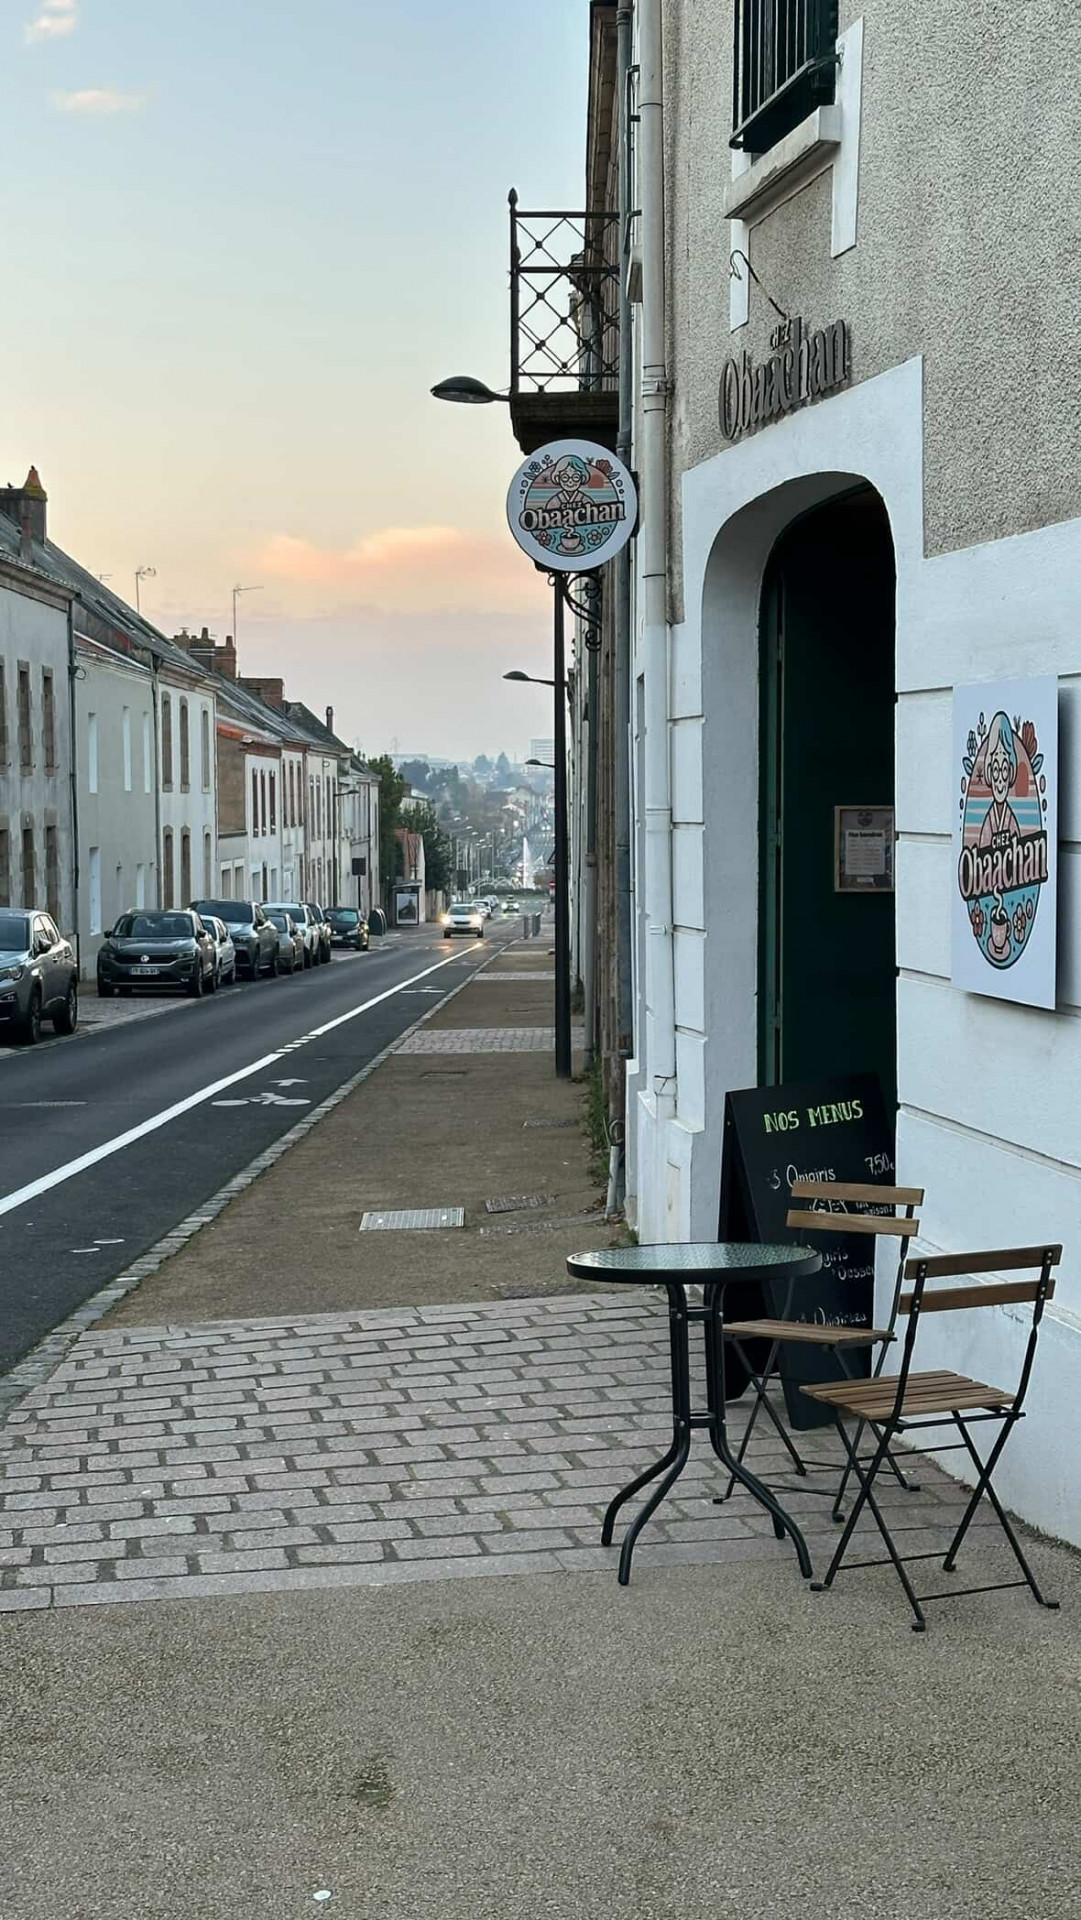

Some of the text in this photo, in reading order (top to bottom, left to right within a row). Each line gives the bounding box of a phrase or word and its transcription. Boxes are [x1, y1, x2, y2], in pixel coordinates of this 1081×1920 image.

[718, 316, 847, 440] Obaachan
[520, 502, 625, 531] Obaachan
[561, 502, 582, 510] CHEZ
[991, 832, 1011, 849] CHEZ
[960, 836, 1048, 894] Obaachan
[763, 1099, 864, 1133] NOS MENUS
